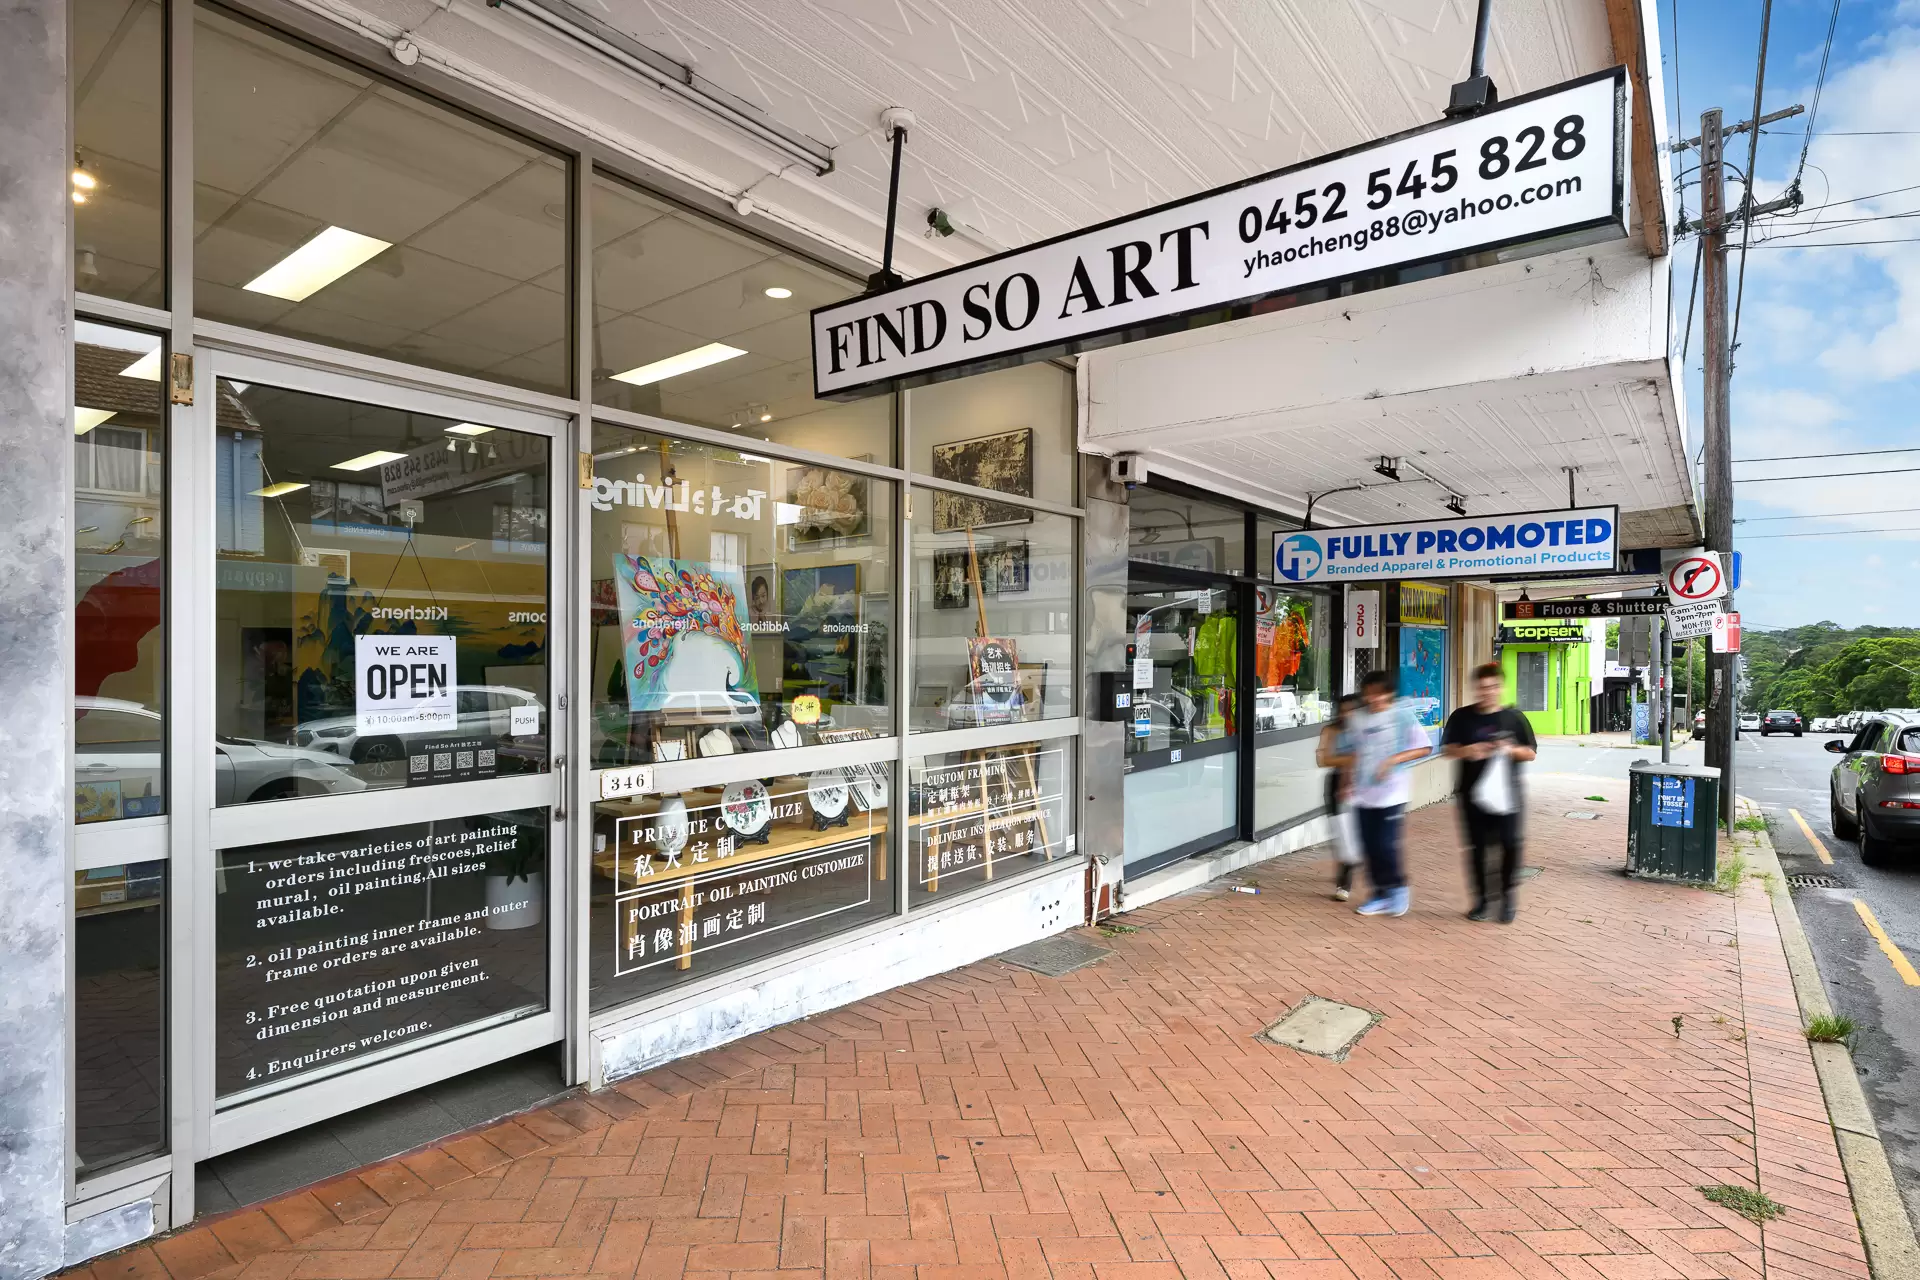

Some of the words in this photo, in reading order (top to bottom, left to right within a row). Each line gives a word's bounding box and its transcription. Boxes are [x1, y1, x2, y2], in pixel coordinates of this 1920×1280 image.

[1238, 182, 1348, 244] 0452
[1366, 148, 1459, 211] 545
[1477, 113, 1587, 181] 828
[1243, 172, 1582, 279] yhaocheng88@yahoo.com
[825, 299, 946, 375] FIND
[962, 271, 1040, 344] SO
[1058, 221, 1209, 320] ART
[1328, 532, 1411, 559] FULLY
[1417, 519, 1611, 554] PROMOTED
[1328, 563, 1378, 575] Branded
[1382, 559, 1433, 573] Apparel
[1437, 559, 1445, 568] &
[1450, 553, 1537, 568] Promotional
[1541, 550, 1610, 564] Products
[1519, 605, 1531, 613] SE
[1543, 605, 1585, 615] Floors
[1591, 604, 1601, 613] &
[1607, 601, 1670, 613] Shutters
[1671, 603, 1716, 615] 6am-10am
[1676, 629, 1692, 637] BUSES
[1682, 620, 1712, 630] MON-FRI
[375, 647, 400, 656] WE
[406, 647, 439, 656] ARE
[982, 662, 1012, 673] 培训招生
[987, 647, 1002, 659] 艺术
[367, 664, 447, 700] OPEN
[377, 712, 450, 725] 10:00am-5:00pm
[515, 717, 535, 725] PUSH
[1136, 708, 1150, 719] OPEN
[611, 774, 646, 790] 346
[927, 770, 964, 786] CUSTOM
[968, 765, 1006, 779] FRAMING
[927, 784, 970, 804] 定制框架
[633, 818, 708, 844] PRIVATE
[715, 801, 803, 832] CSTMIZE
[927, 829, 968, 847] DELIVERY
[247, 861, 262, 874] 1.
[268, 858, 292, 871] we
[298, 851, 336, 867] take
[341, 839, 412, 860] varieties
[416, 835, 432, 848] of
[435, 833, 456, 845] art
[460, 824, 517, 844] painting
[633, 835, 736, 879] 私人定制
[256, 889, 318, 910] mural,
[328, 882, 351, 897] oil
[451, 860, 486, 876] sizes
[265, 869, 325, 890] orders
[329, 857, 405, 880] including
[629, 892, 705, 923] PORTRAIT
[710, 882, 734, 902] OIL
[738, 869, 798, 896] PAINTING
[801, 853, 864, 880] CUSTOMIZE
[246, 955, 262, 968] 2.
[268, 948, 293, 964] oil
[297, 932, 369, 960] painting
[373, 923, 414, 941] inner
[419, 912, 461, 931] frame
[464, 906, 489, 921] and
[492, 899, 529, 915] outer
[256, 905, 344, 929] available.
[628, 901, 765, 960] 肖像油画定制
[265, 962, 318, 983] frame
[323, 949, 377, 969] orders
[381, 941, 406, 955] are
[410, 926, 481, 949] available.
[246, 1011, 262, 1025] 3.
[268, 999, 309, 1020] Free
[314, 977, 396, 1009] quotation
[400, 968, 437, 987] upon
[441, 956, 479, 978] given
[256, 1003, 348, 1041] dimension
[352, 998, 382, 1015] and
[386, 971, 489, 1006] measurement.
[246, 1067, 262, 1081] 4.
[268, 1041, 356, 1075] Enquirers
[360, 1019, 432, 1046] welcome.
